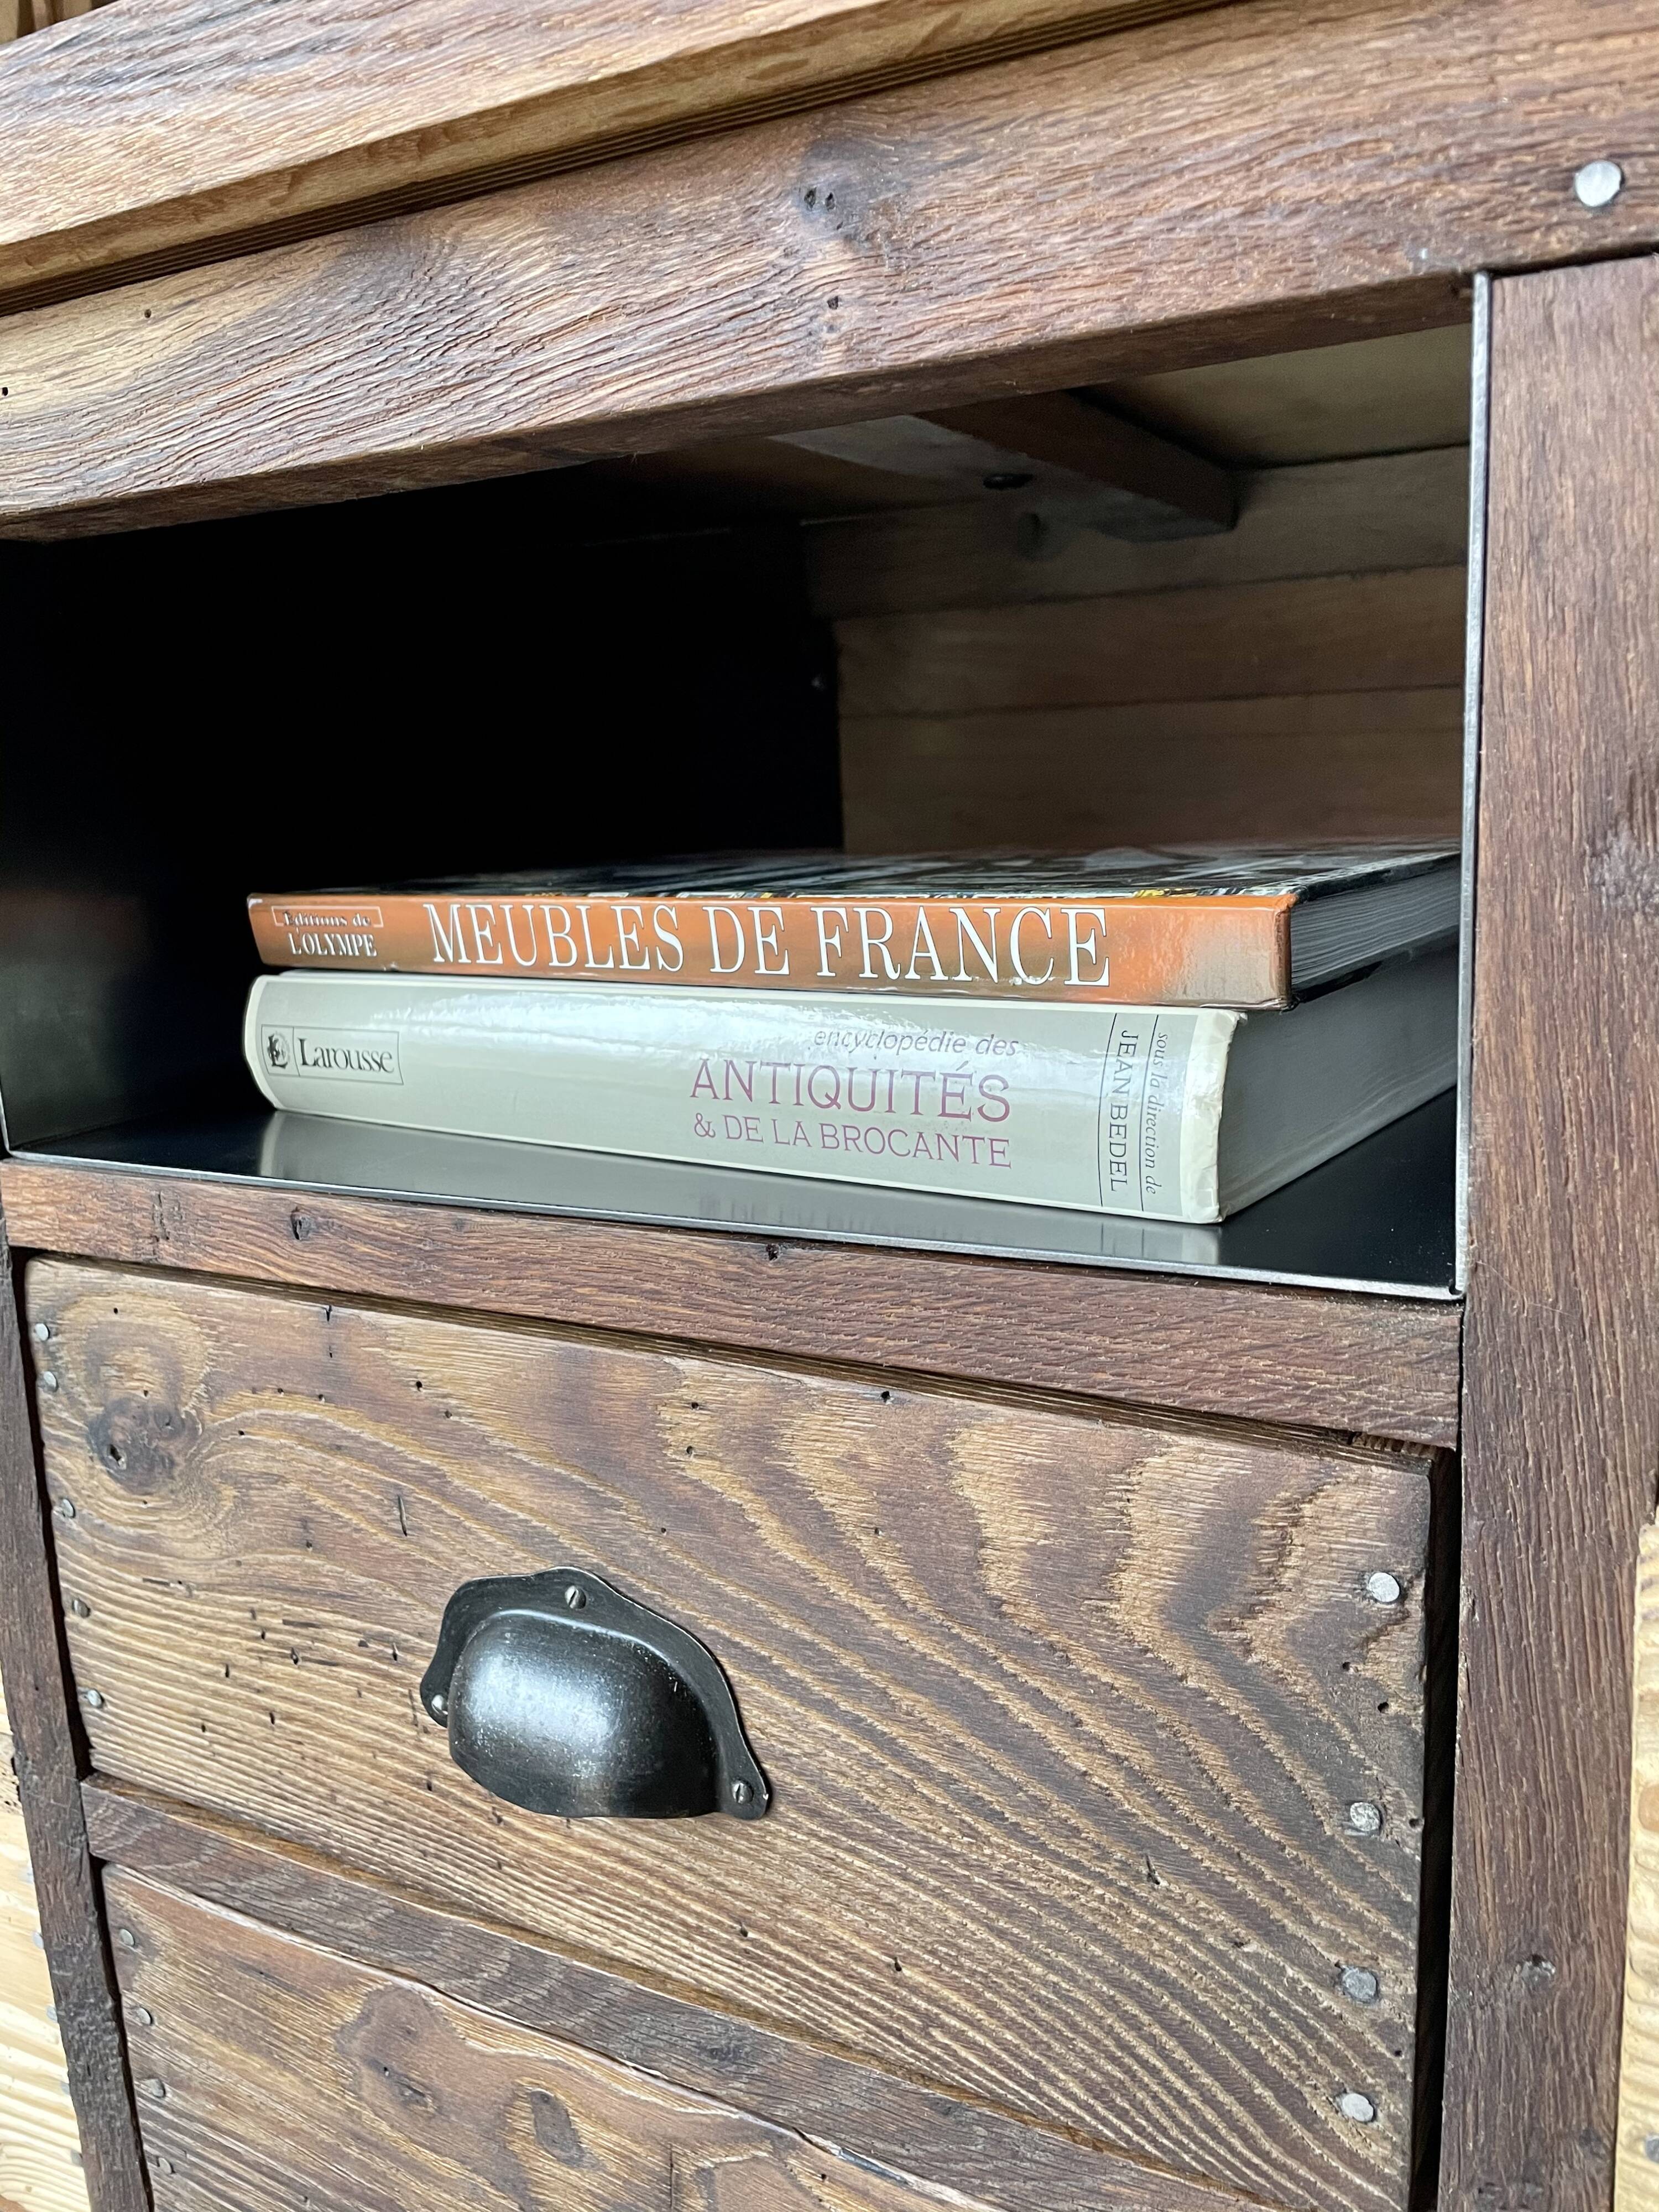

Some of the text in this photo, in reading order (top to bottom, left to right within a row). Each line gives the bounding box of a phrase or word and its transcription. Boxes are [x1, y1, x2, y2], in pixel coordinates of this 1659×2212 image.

[283, 911, 372, 927] Éditions de
[288, 927, 377, 957] L'OLYMPE
[422, 902, 1110, 988] MEUBLES DE FRANCE
[298, 1037, 394, 1073] Larousse
[813, 1027, 1019, 1057] encyclopédie des
[690, 1058, 1010, 1123] ANTIQUITÉS
[1109, 1029, 1139, 1192] JEAN BEDEL
[1145, 1032, 1168, 1195] sous la direction de
[693, 1112, 1012, 1169] & DE LA BROCANTE
